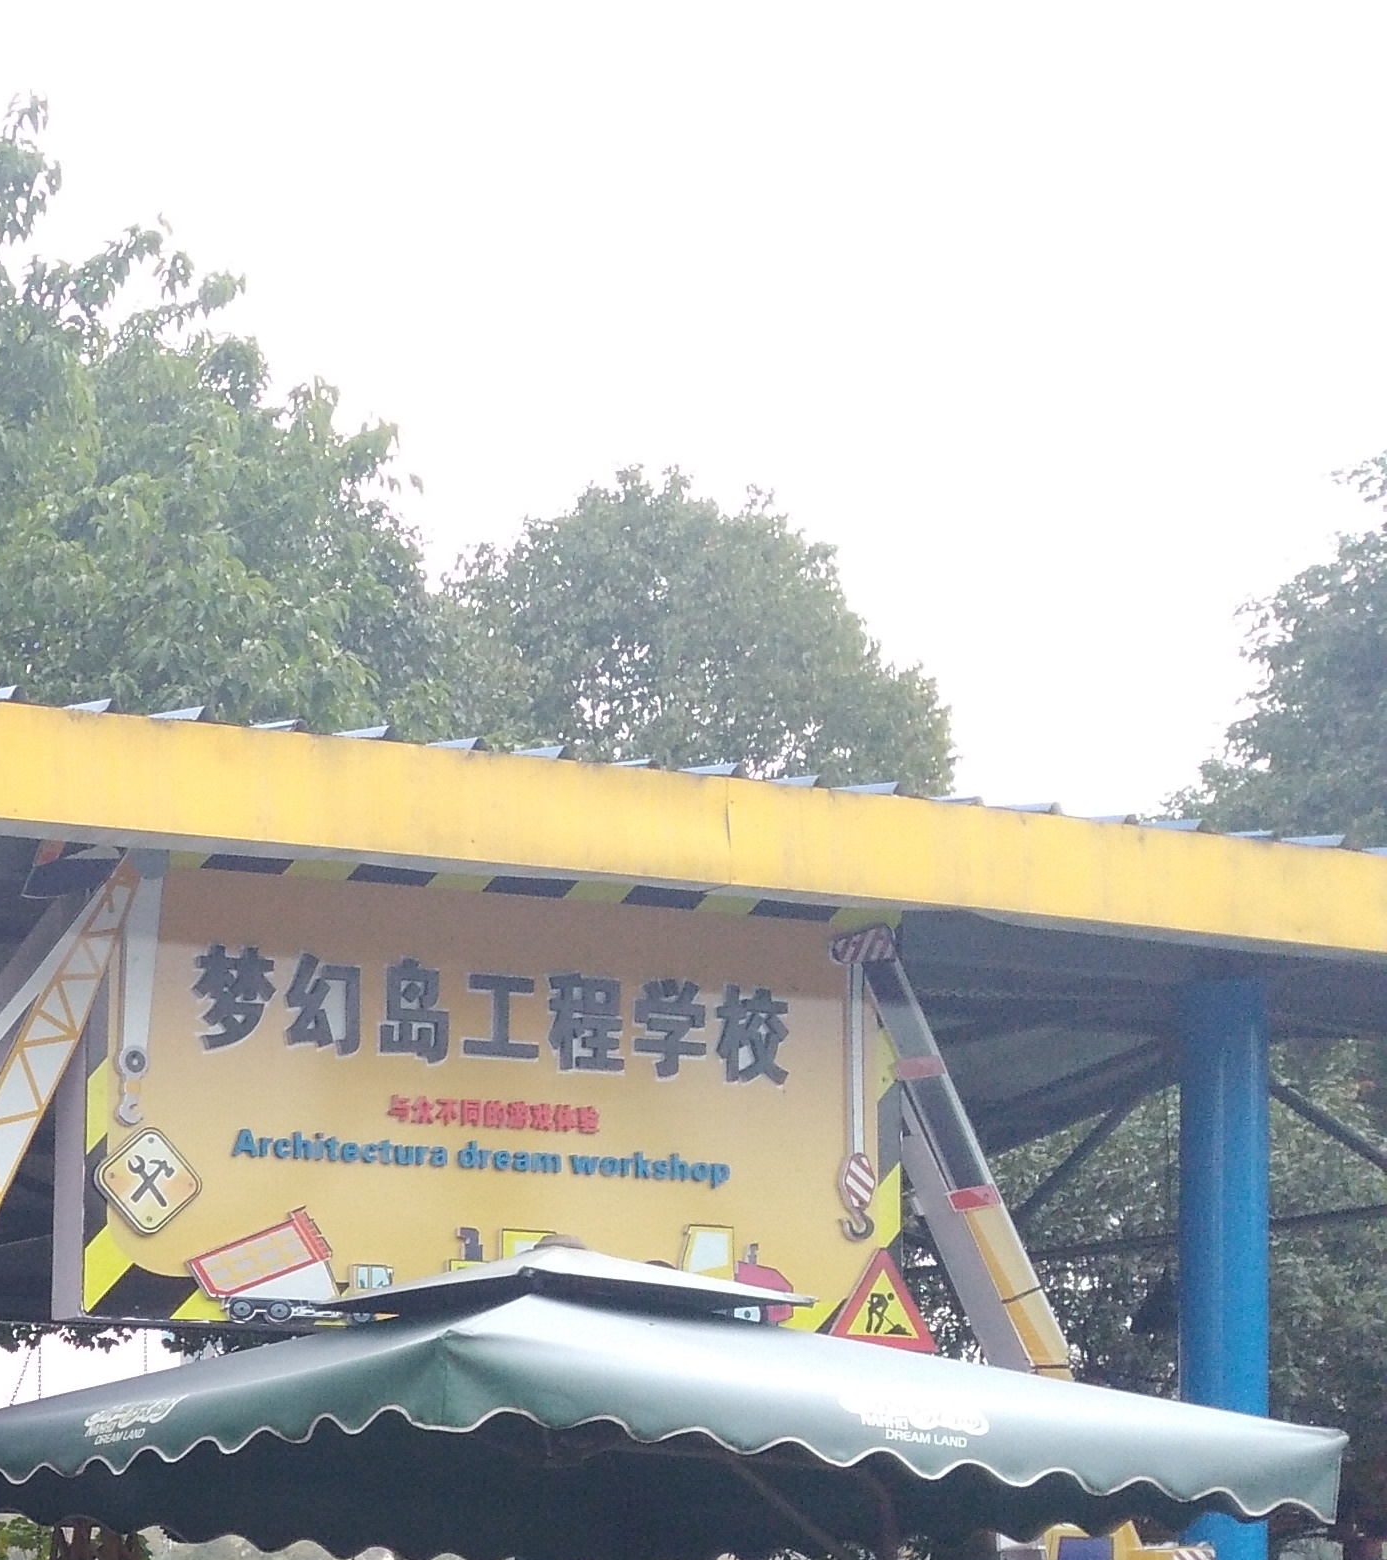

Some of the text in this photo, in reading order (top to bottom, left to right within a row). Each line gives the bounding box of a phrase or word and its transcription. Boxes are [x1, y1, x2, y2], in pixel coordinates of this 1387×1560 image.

[191, 943, 790, 1086] 梦幻岛工程学校
[231, 1128, 731, 1189] Architectura dream workshop
[94, 1427, 146, 1446] DREAM LAND
[885, 1429, 968, 1448] DREAM LAND
